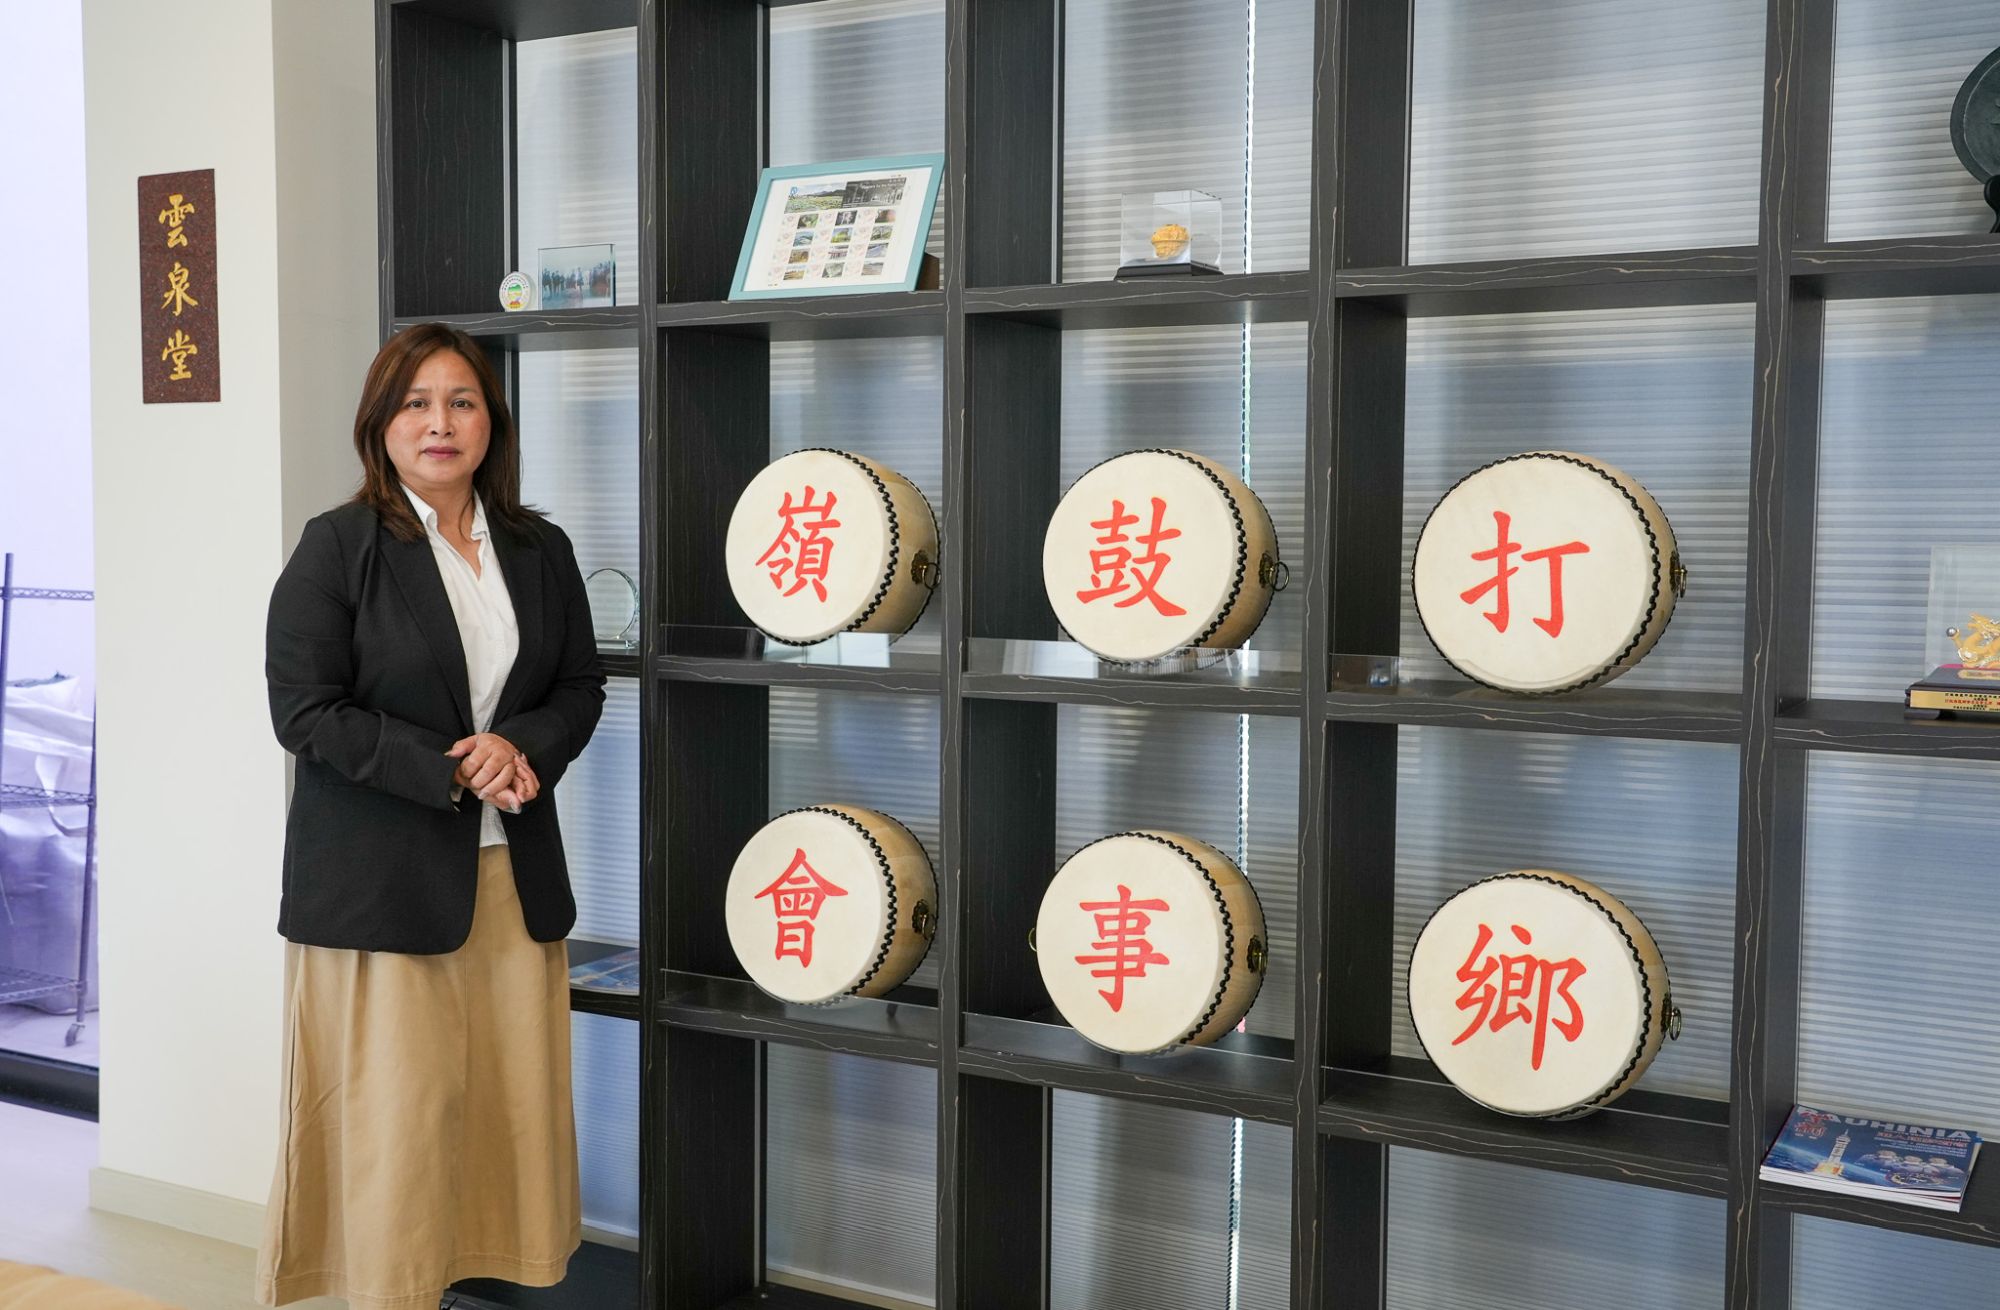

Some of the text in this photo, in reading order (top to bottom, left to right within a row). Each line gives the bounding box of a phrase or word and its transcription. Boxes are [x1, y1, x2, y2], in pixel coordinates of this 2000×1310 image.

[158, 193, 199, 381] 雲泉堂
[756, 485, 842, 604] 嶺
[1076, 496, 1189, 618] 鼓
[1459, 510, 1591, 640] 打
[754, 847, 849, 969] 會
[1075, 884, 1171, 1013] 事
[1451, 923, 1589, 1072] 鄉
